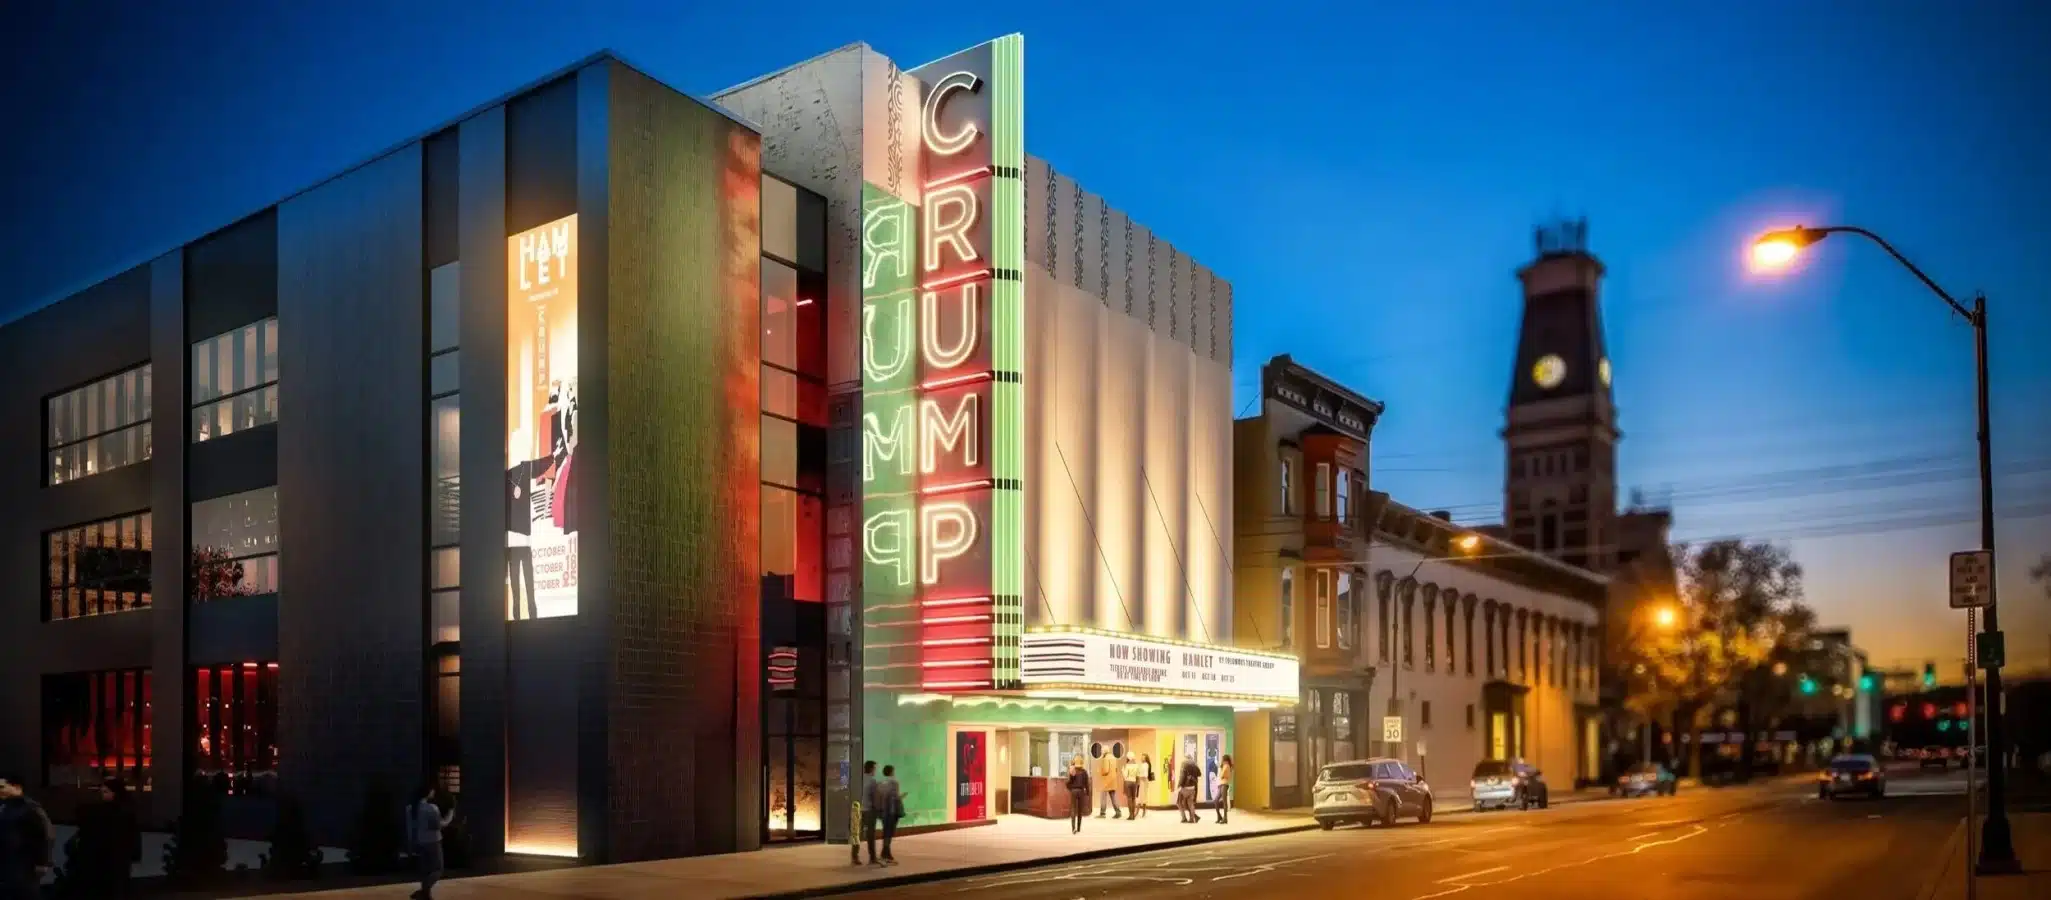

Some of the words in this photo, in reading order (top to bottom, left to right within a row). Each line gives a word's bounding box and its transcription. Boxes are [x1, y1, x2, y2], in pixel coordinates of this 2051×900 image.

[519, 222, 569, 263] HAM
[519, 254, 568, 291] LET
[921, 70, 982, 586] CRUMP
[532, 545, 566, 559] OCTOBER
[568, 537, 577, 554] 11
[535, 562, 564, 575] CTOBER
[565, 554, 577, 571] 18
[562, 570, 577, 588] 25
[1109, 643, 1129, 660] NOW
[1132, 646, 1171, 664] SHOWING
[1182, 652, 1213, 668] HAMLET
[1386, 728, 1400, 739] 30
